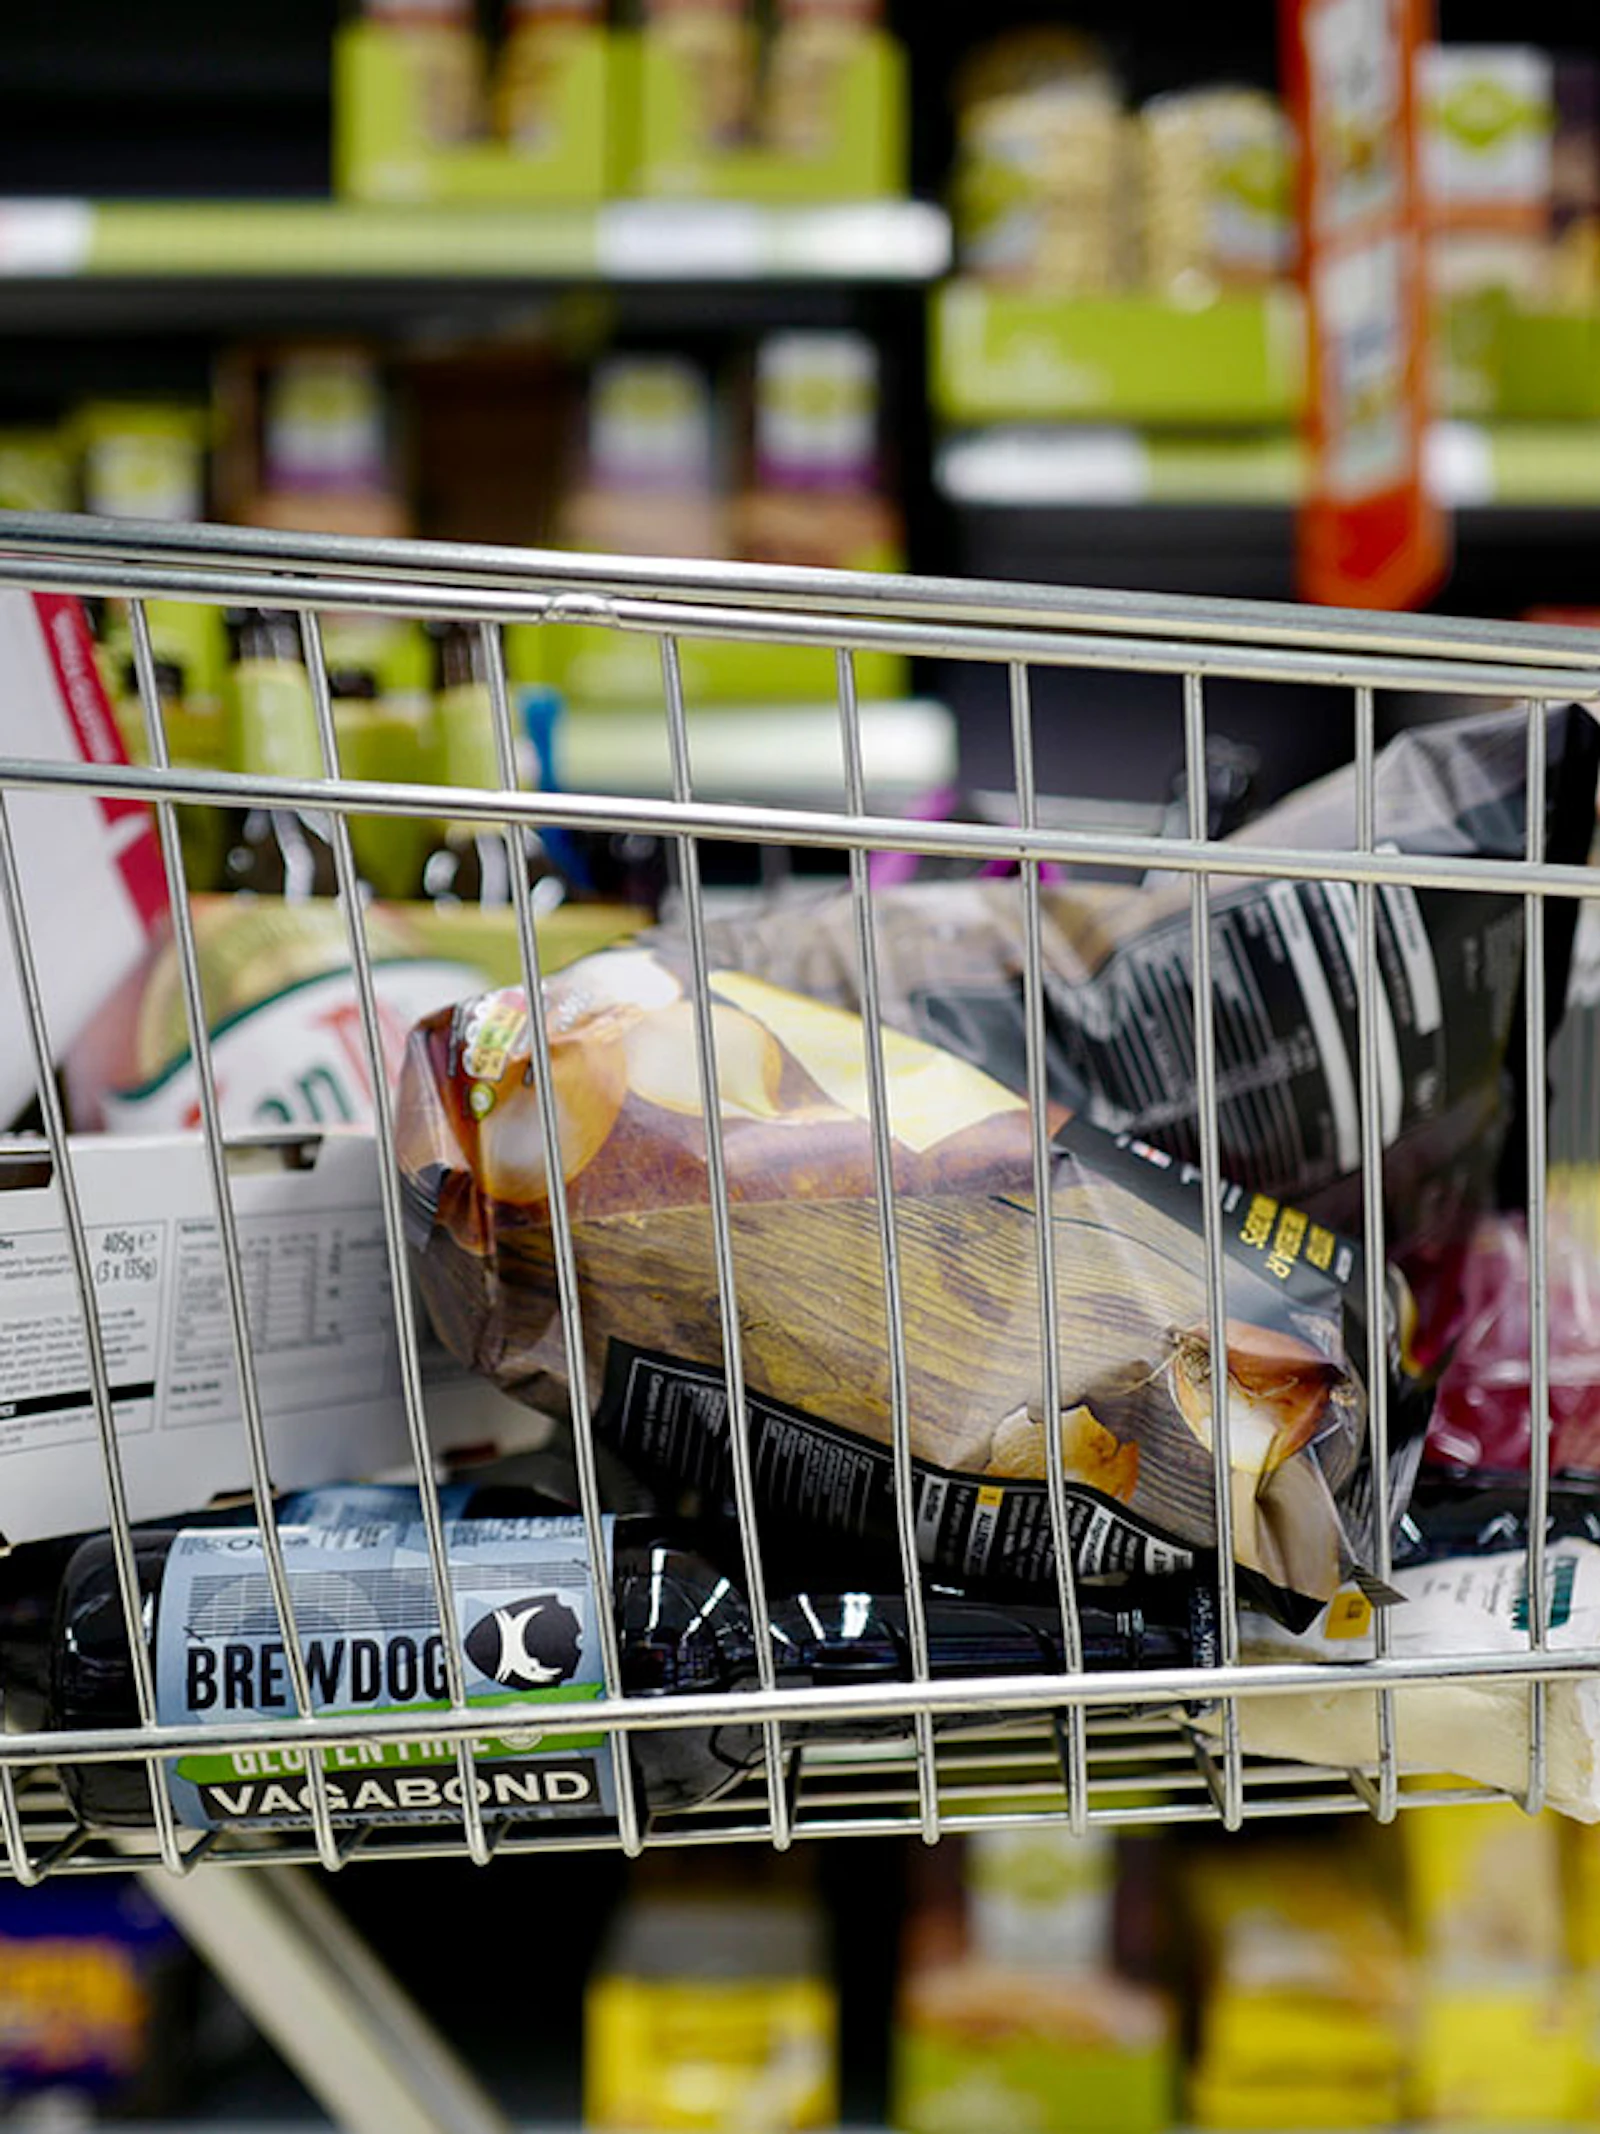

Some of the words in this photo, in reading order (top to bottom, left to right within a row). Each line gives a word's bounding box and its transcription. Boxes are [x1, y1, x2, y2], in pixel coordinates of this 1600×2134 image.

[102, 1231, 135, 1256] 405g
[186, 1635, 451, 1711] BREWDOG
[208, 1769, 592, 1815] VAGABOND
